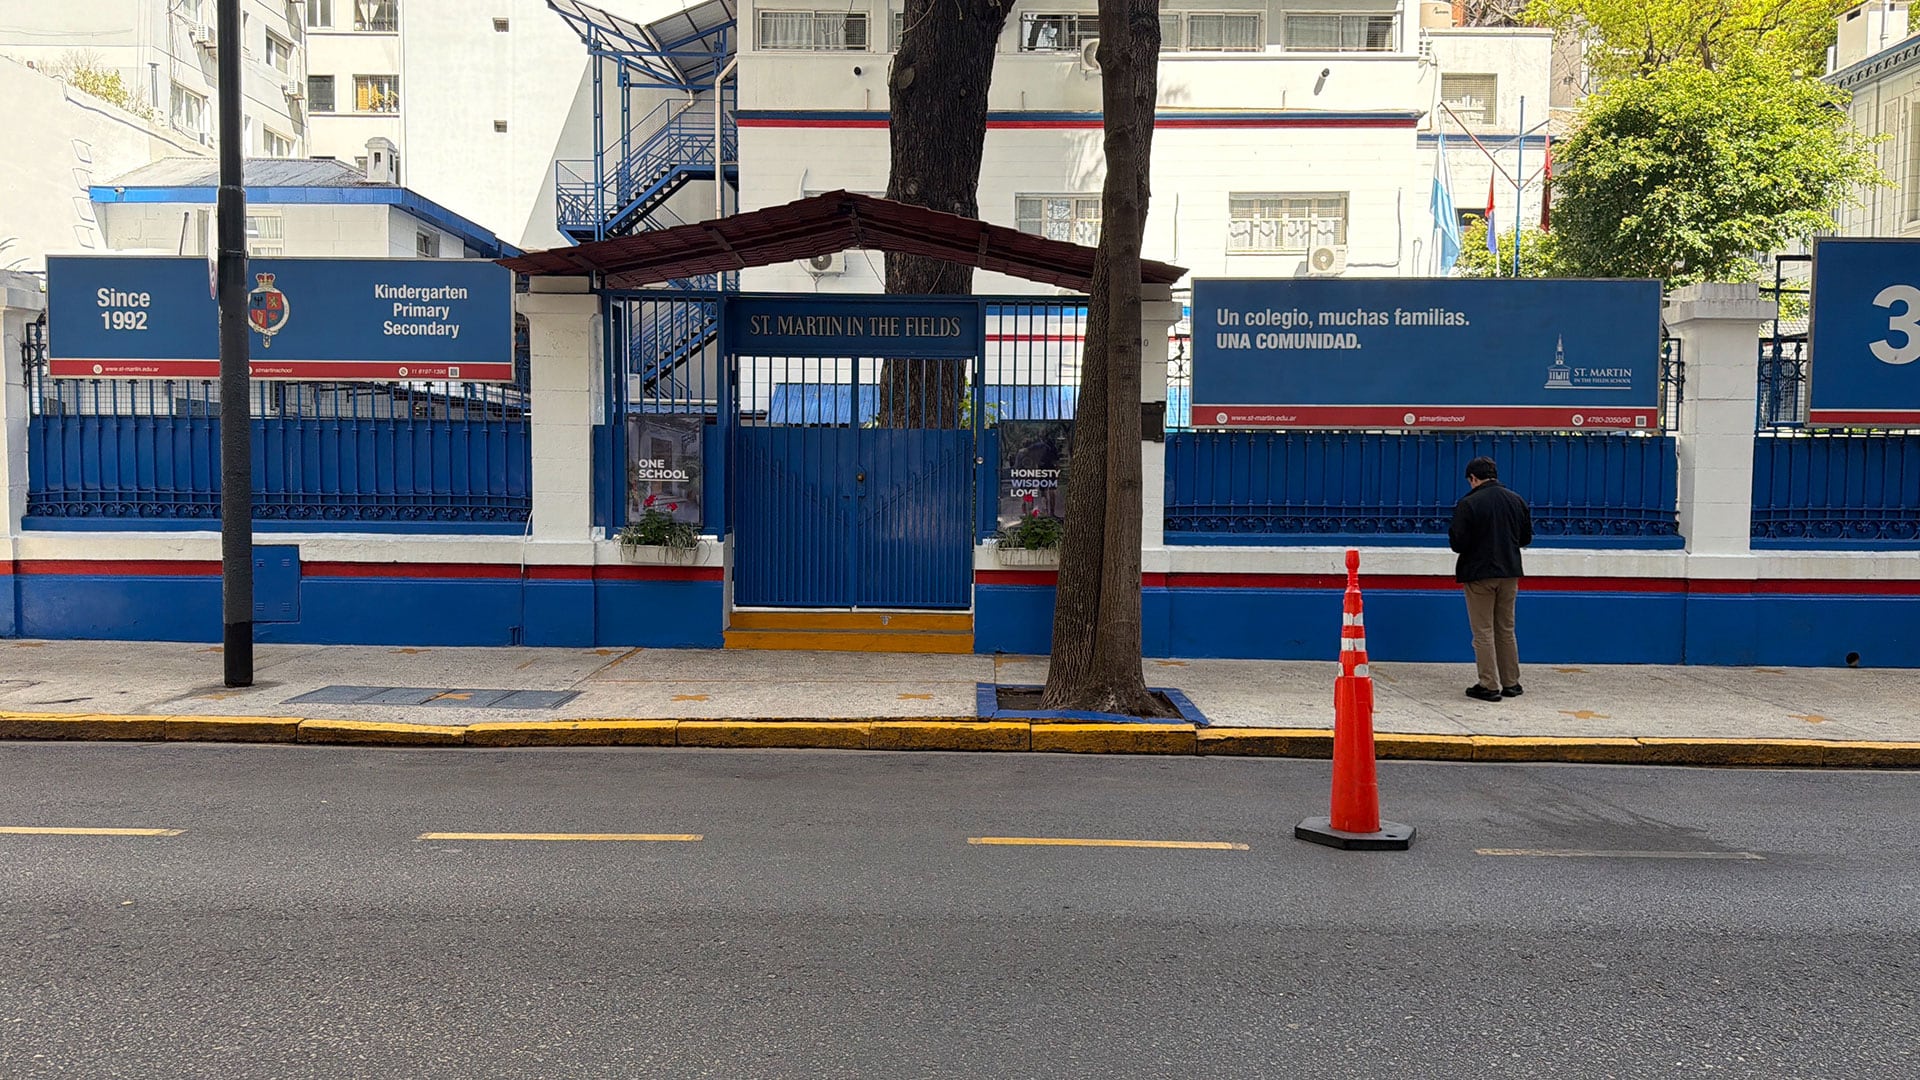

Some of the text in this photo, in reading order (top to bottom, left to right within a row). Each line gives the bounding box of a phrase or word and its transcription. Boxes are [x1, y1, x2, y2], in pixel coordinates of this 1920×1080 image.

[97, 288, 151, 308] Since
[374, 284, 468, 302] Kindergarten
[393, 303, 450, 320] Primary
[101, 310, 148, 330] 1992
[750, 315, 961, 337] ST. MARTIN IN THE FIELDS
[1217, 308, 1470, 330] Un colegio, muchas familias.
[383, 320, 460, 339] Secondary
[1216, 333, 1362, 350] UNA COMUNIDAD.
[1574, 368, 1632, 377] ST. MARTIN
[1231, 414, 1297, 422] www.st-martin.edu.ar
[1418, 415, 1466, 423] stmartinschool
[638, 458, 665, 469] ONE
[638, 469, 689, 480] SCHOOL
[1010, 469, 1061, 478] HONESTY
[1011, 478, 1058, 488] WISDOM
[1010, 488, 1039, 498] LOVE
